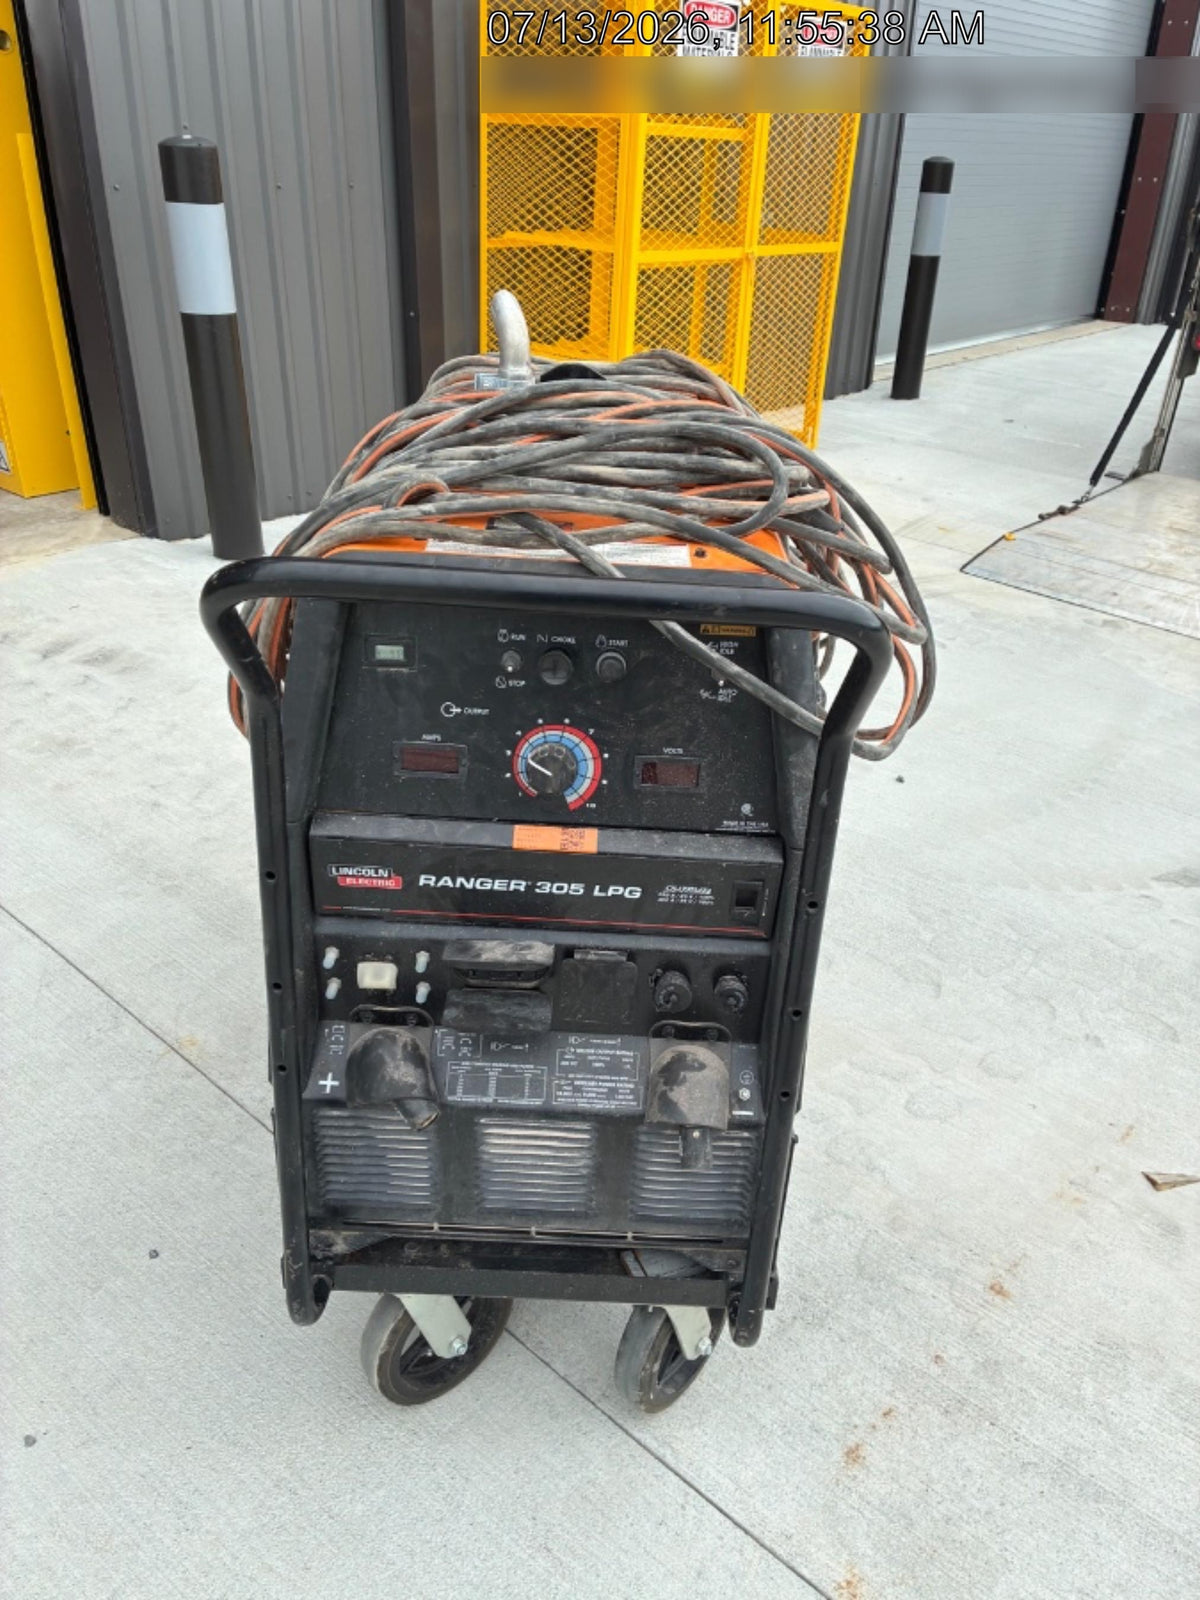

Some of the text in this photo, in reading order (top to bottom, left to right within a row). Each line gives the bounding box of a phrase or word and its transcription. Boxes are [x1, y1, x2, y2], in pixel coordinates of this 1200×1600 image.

[331, 866, 389, 878] LINCOLN
[345, 876, 396, 887] ELECTRIC
[418, 874, 527, 892] RANGER
[534, 880, 585, 896] 305
[593, 884, 642, 899] LPG
